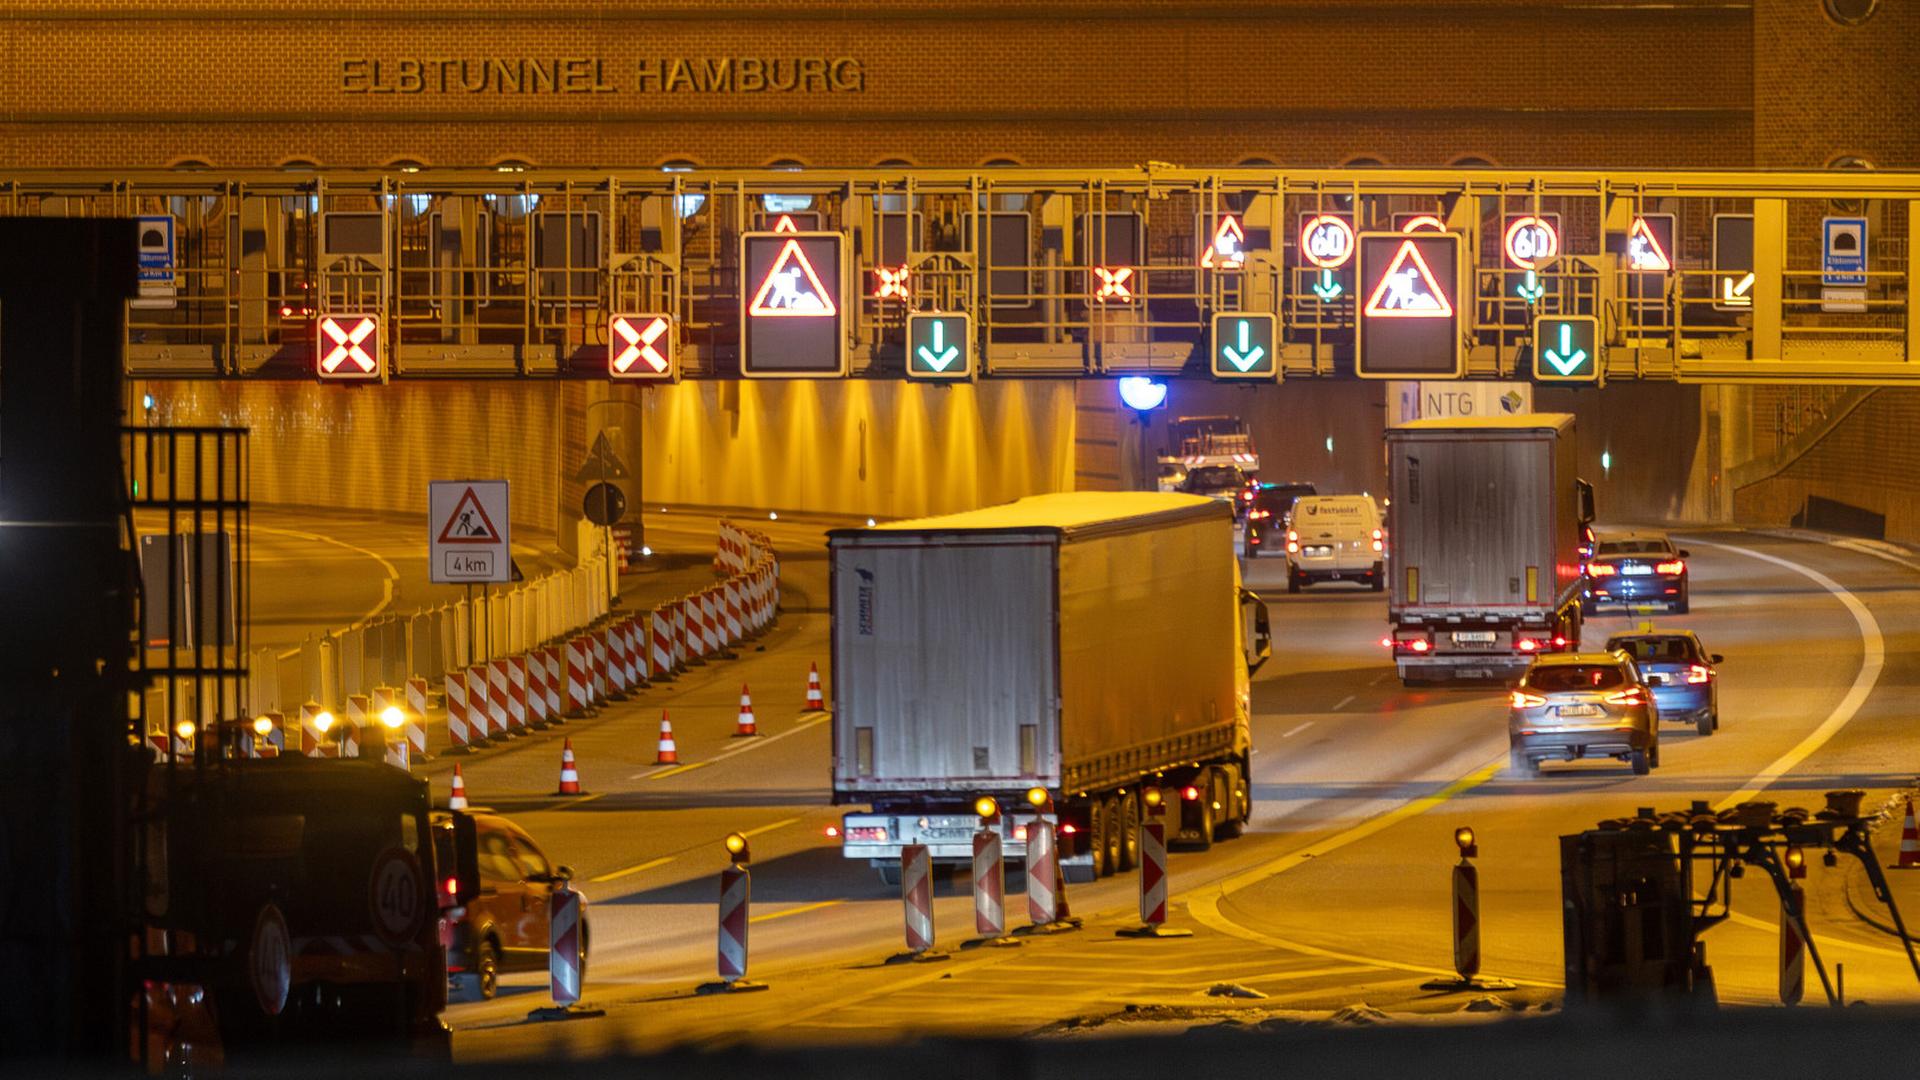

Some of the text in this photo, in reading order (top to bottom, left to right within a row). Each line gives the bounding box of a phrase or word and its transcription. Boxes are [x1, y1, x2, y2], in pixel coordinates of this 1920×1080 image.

[340, 57, 867, 94] ELBTUNNEL HAMBURG
[1309, 225, 1345, 257] 60
[1514, 227, 1548, 258] 60
[1427, 392, 1473, 416] NTG
[454, 556, 486, 571] 4 km
[920, 828, 974, 840] SCHMIT
[381, 872, 413, 918] 40
